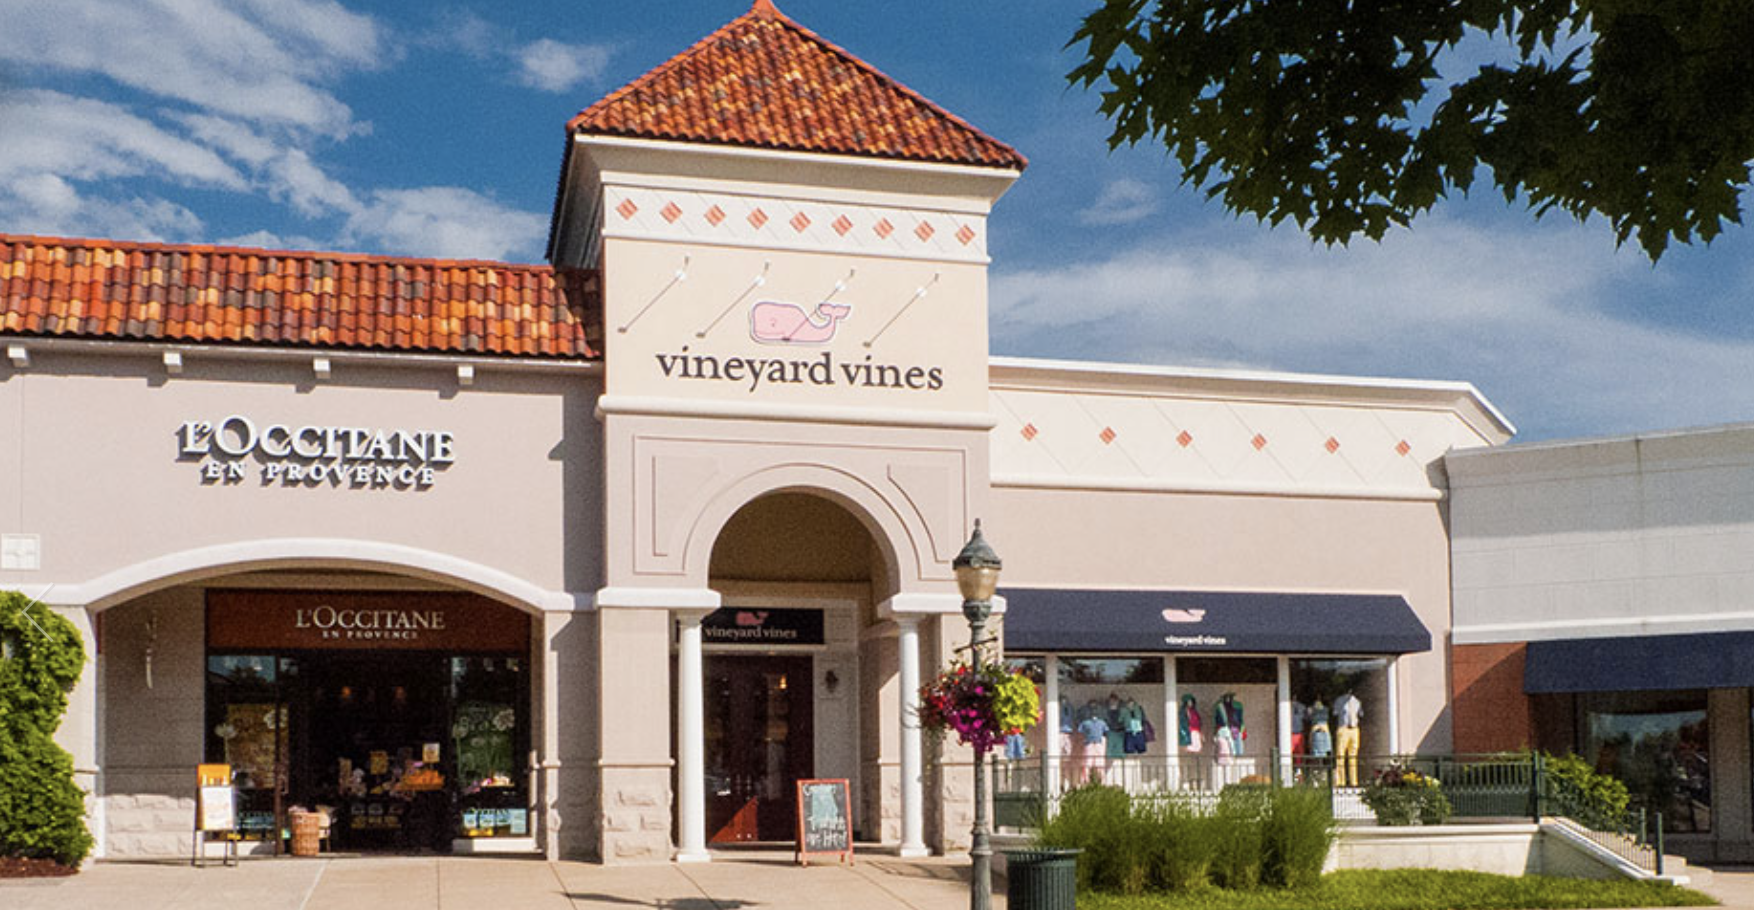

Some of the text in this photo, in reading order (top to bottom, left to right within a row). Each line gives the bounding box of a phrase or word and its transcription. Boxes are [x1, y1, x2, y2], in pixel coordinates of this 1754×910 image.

[656, 346, 943, 392] vineyard vines
[181, 415, 455, 462] L'OCCITANE
[205, 461, 436, 485] EN PROVENCE
[295, 605, 445, 630] L'OCCITANE
[322, 630, 418, 640] EN PROVENCE
[705, 626, 798, 640] vineyard vines
[1164, 634, 1227, 647] vineyard vines
